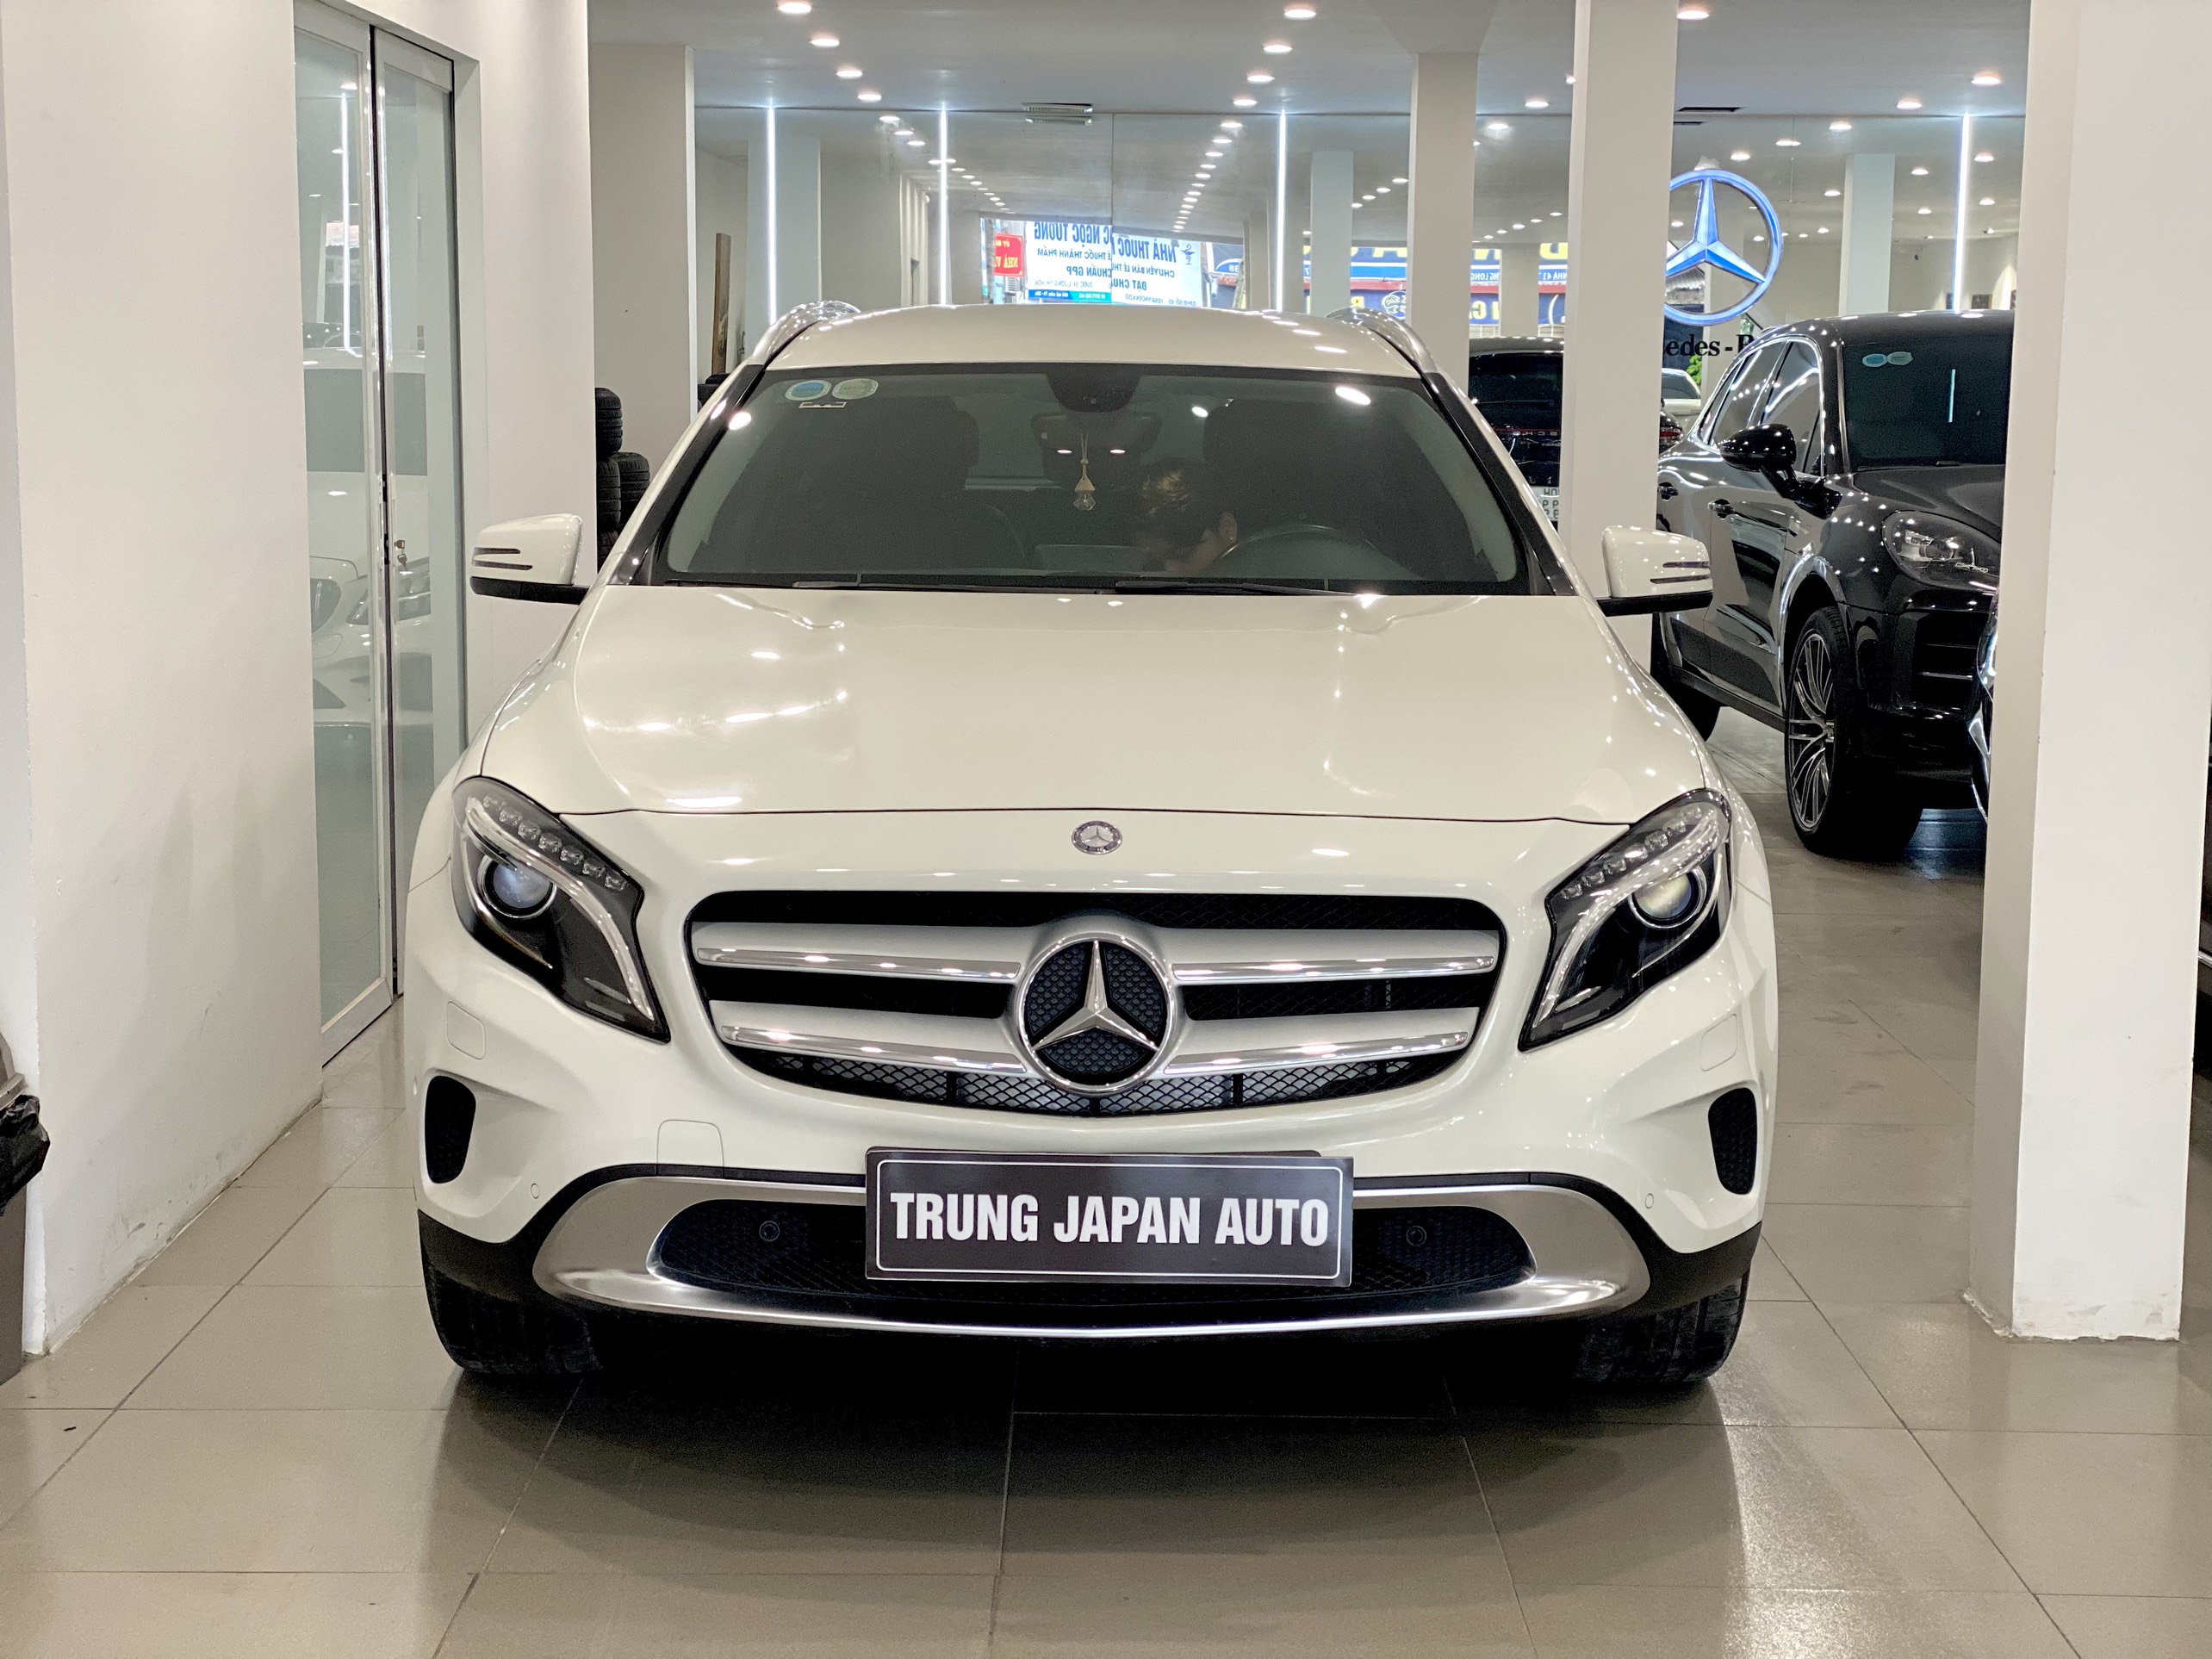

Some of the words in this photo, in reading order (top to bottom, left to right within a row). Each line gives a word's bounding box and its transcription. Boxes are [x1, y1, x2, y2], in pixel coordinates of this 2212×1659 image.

[890, 1193, 1039, 1242] TRUNG
[1053, 1196, 1200, 1245] JAPAN
[1214, 1198, 1329, 1247] AUTO
